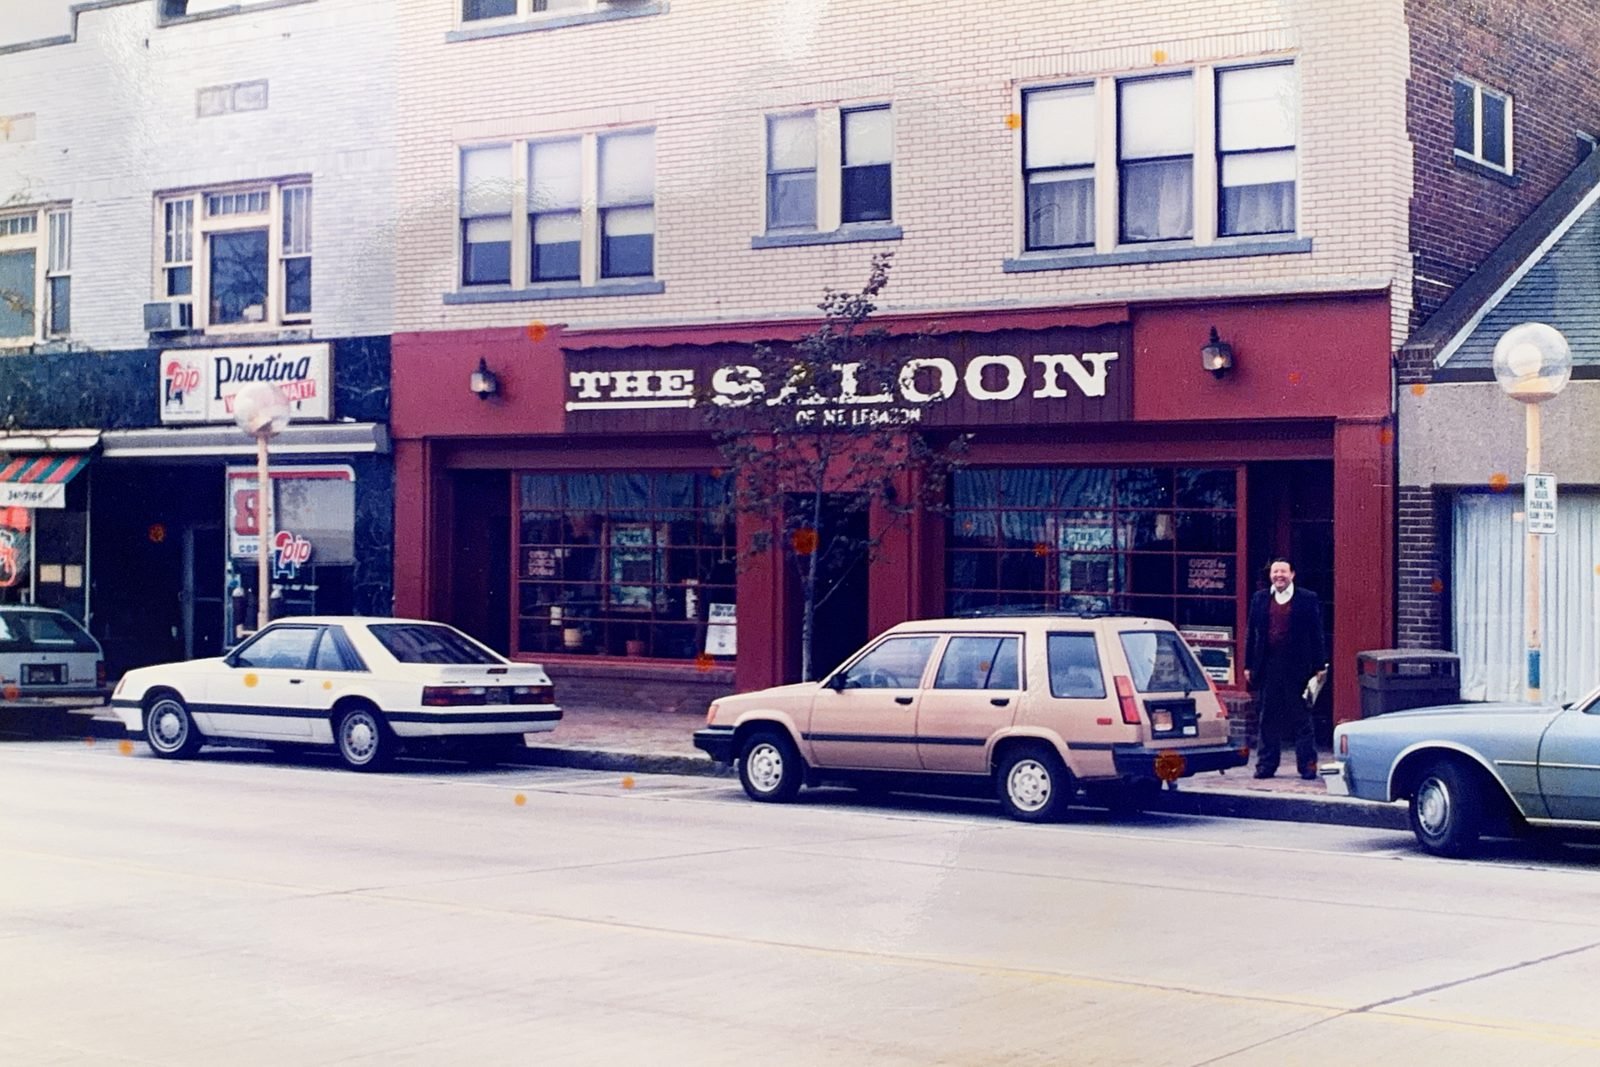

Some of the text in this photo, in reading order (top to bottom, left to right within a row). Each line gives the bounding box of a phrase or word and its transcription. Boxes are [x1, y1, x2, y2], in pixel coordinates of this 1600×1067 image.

[171, 364, 200, 393] pip
[214, 353, 311, 408] Printing
[570, 352, 1118, 407] THE SALOON
[279, 535, 312, 568] pip
